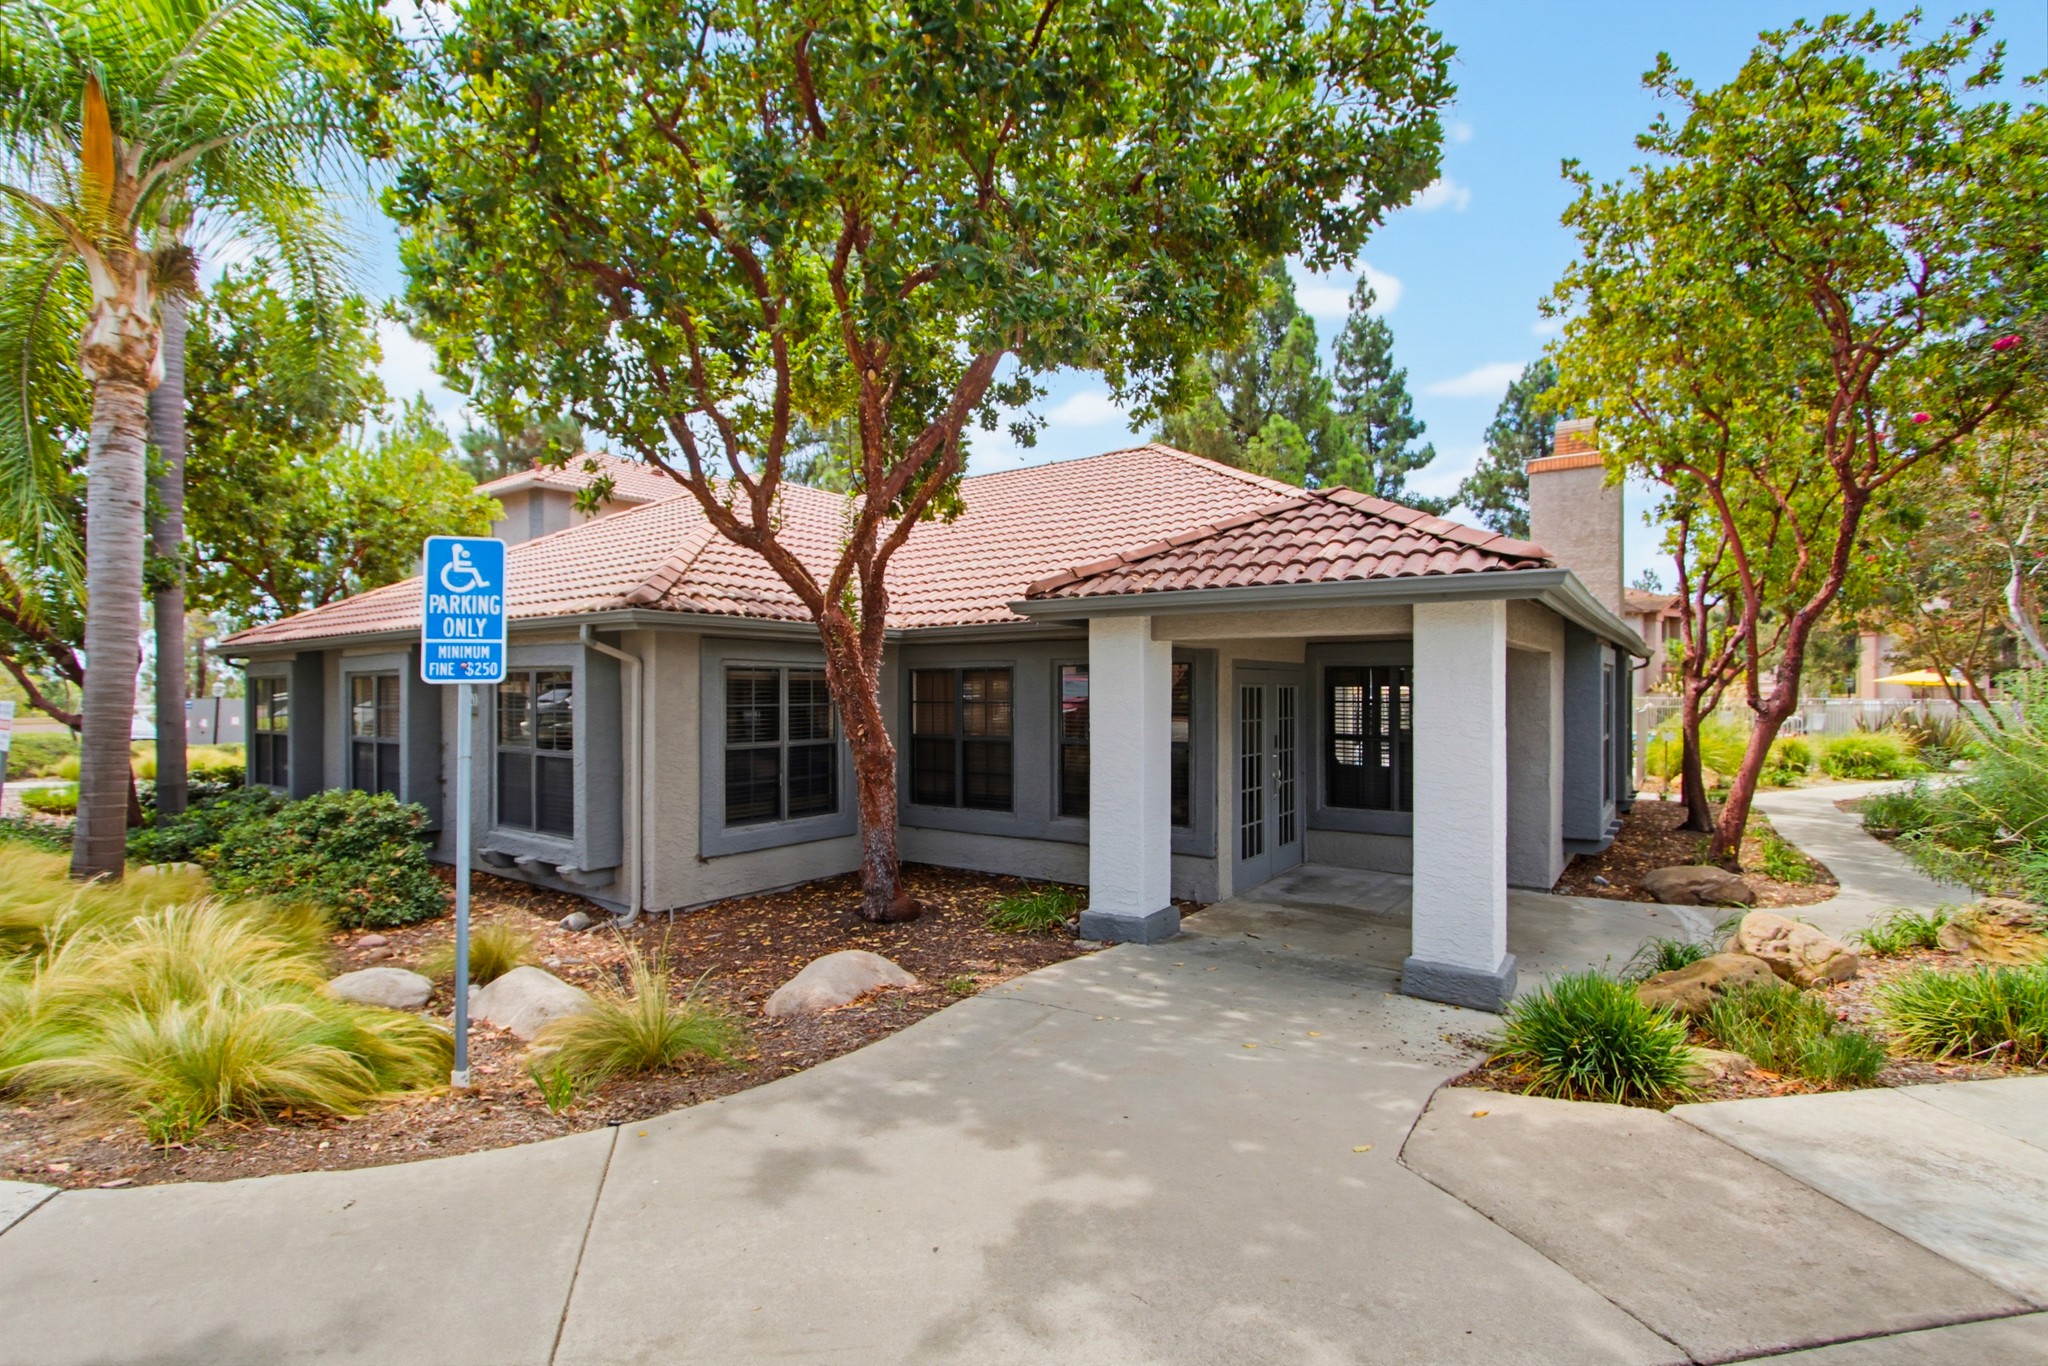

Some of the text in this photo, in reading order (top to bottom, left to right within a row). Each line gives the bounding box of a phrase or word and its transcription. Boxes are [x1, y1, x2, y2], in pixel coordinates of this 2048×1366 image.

[429, 594, 501, 615] PARKING
[443, 617, 487, 637] ONLY
[438, 645, 490, 659] MINIMUM
[429, 661, 498, 676] FINE $250
